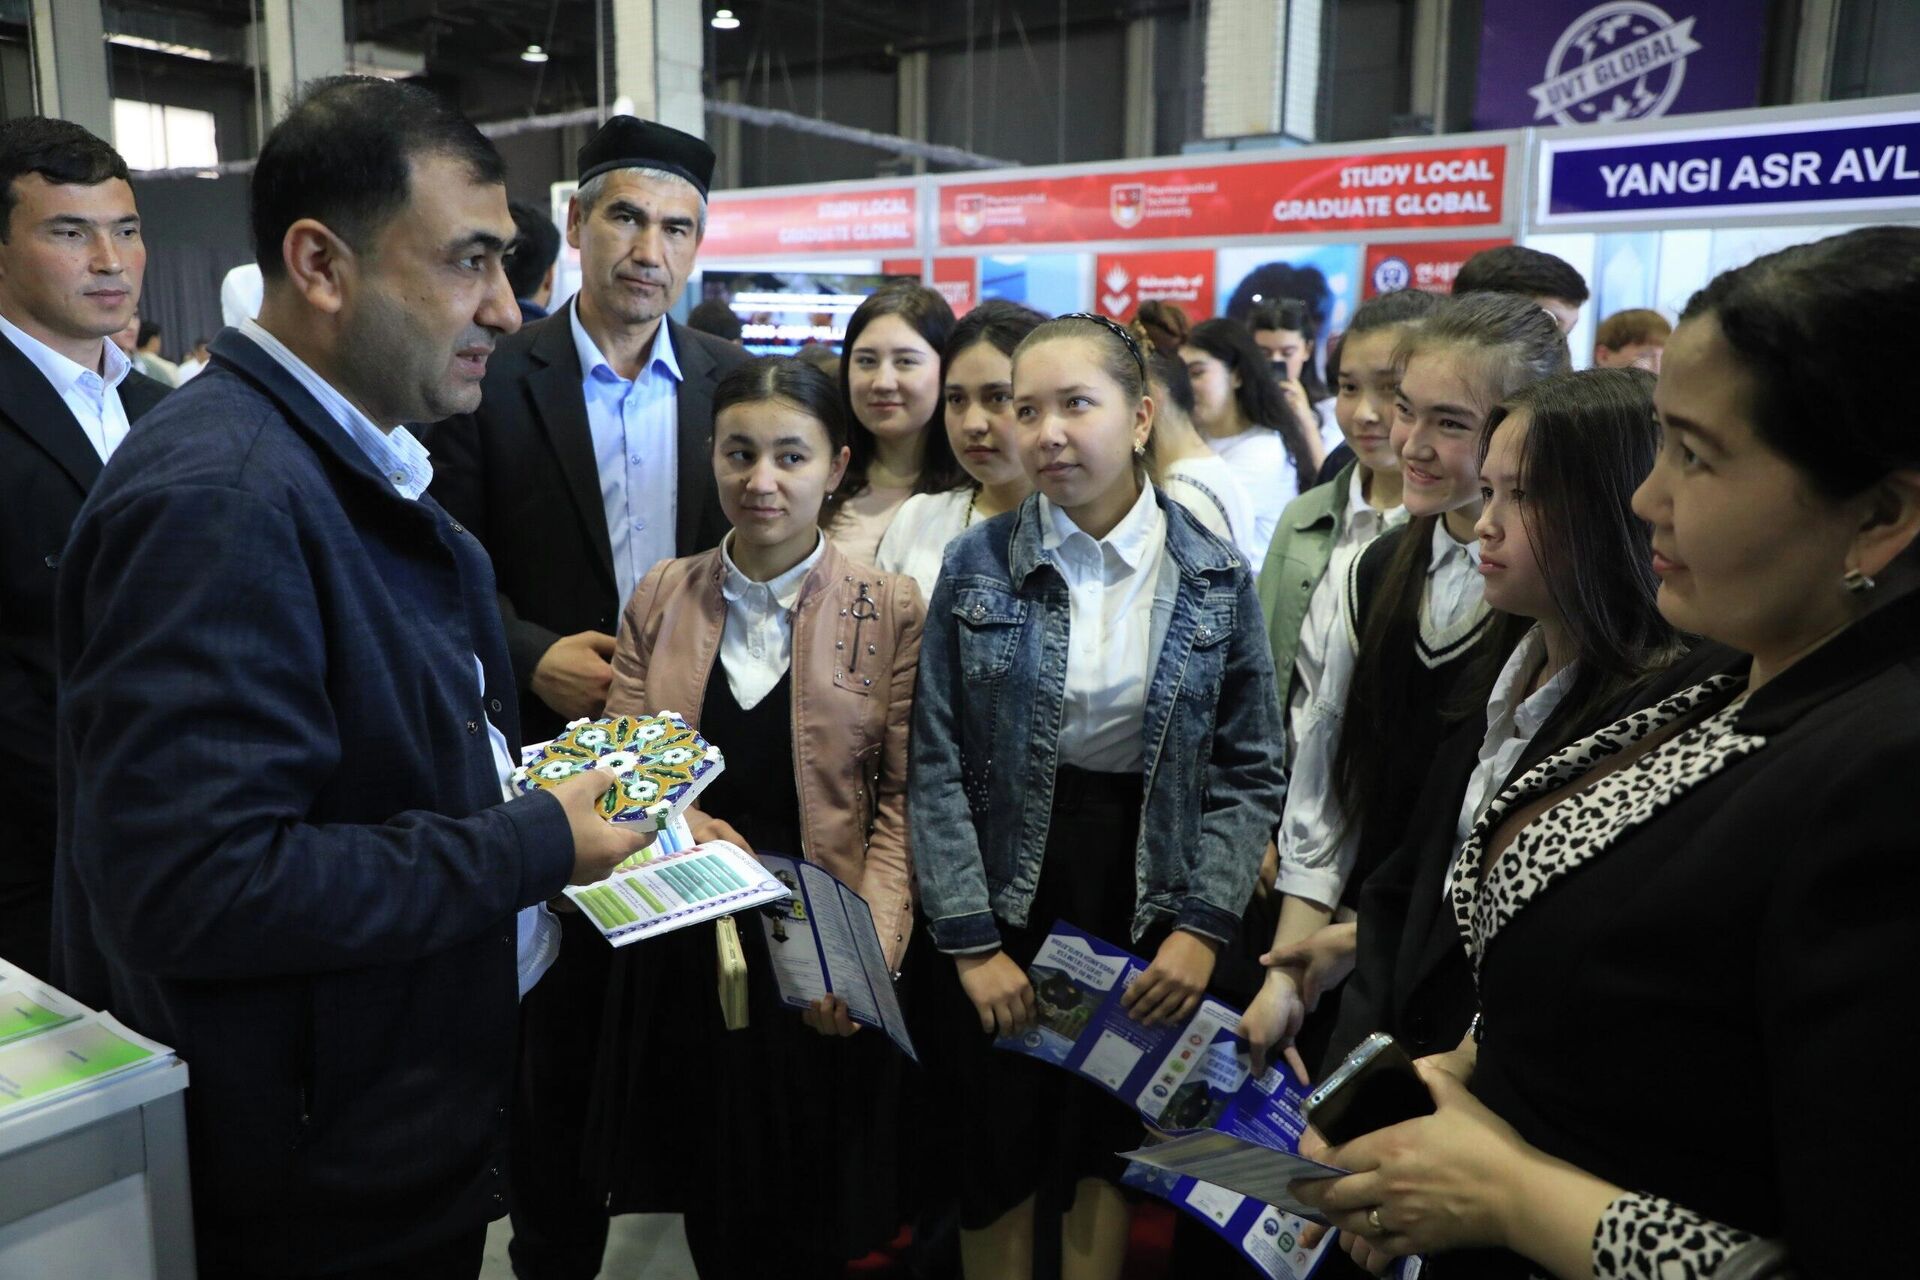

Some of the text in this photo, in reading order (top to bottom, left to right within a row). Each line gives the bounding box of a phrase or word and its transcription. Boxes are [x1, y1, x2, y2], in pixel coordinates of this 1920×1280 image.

[1546, 33, 1676, 104] UVT GLOBAL
[1340, 159, 1494, 188] STUDY LOCAL
[1600, 145, 1920, 198] YANGI ASR AVL
[1273, 191, 1492, 221] GRADUATE GLOBAL
